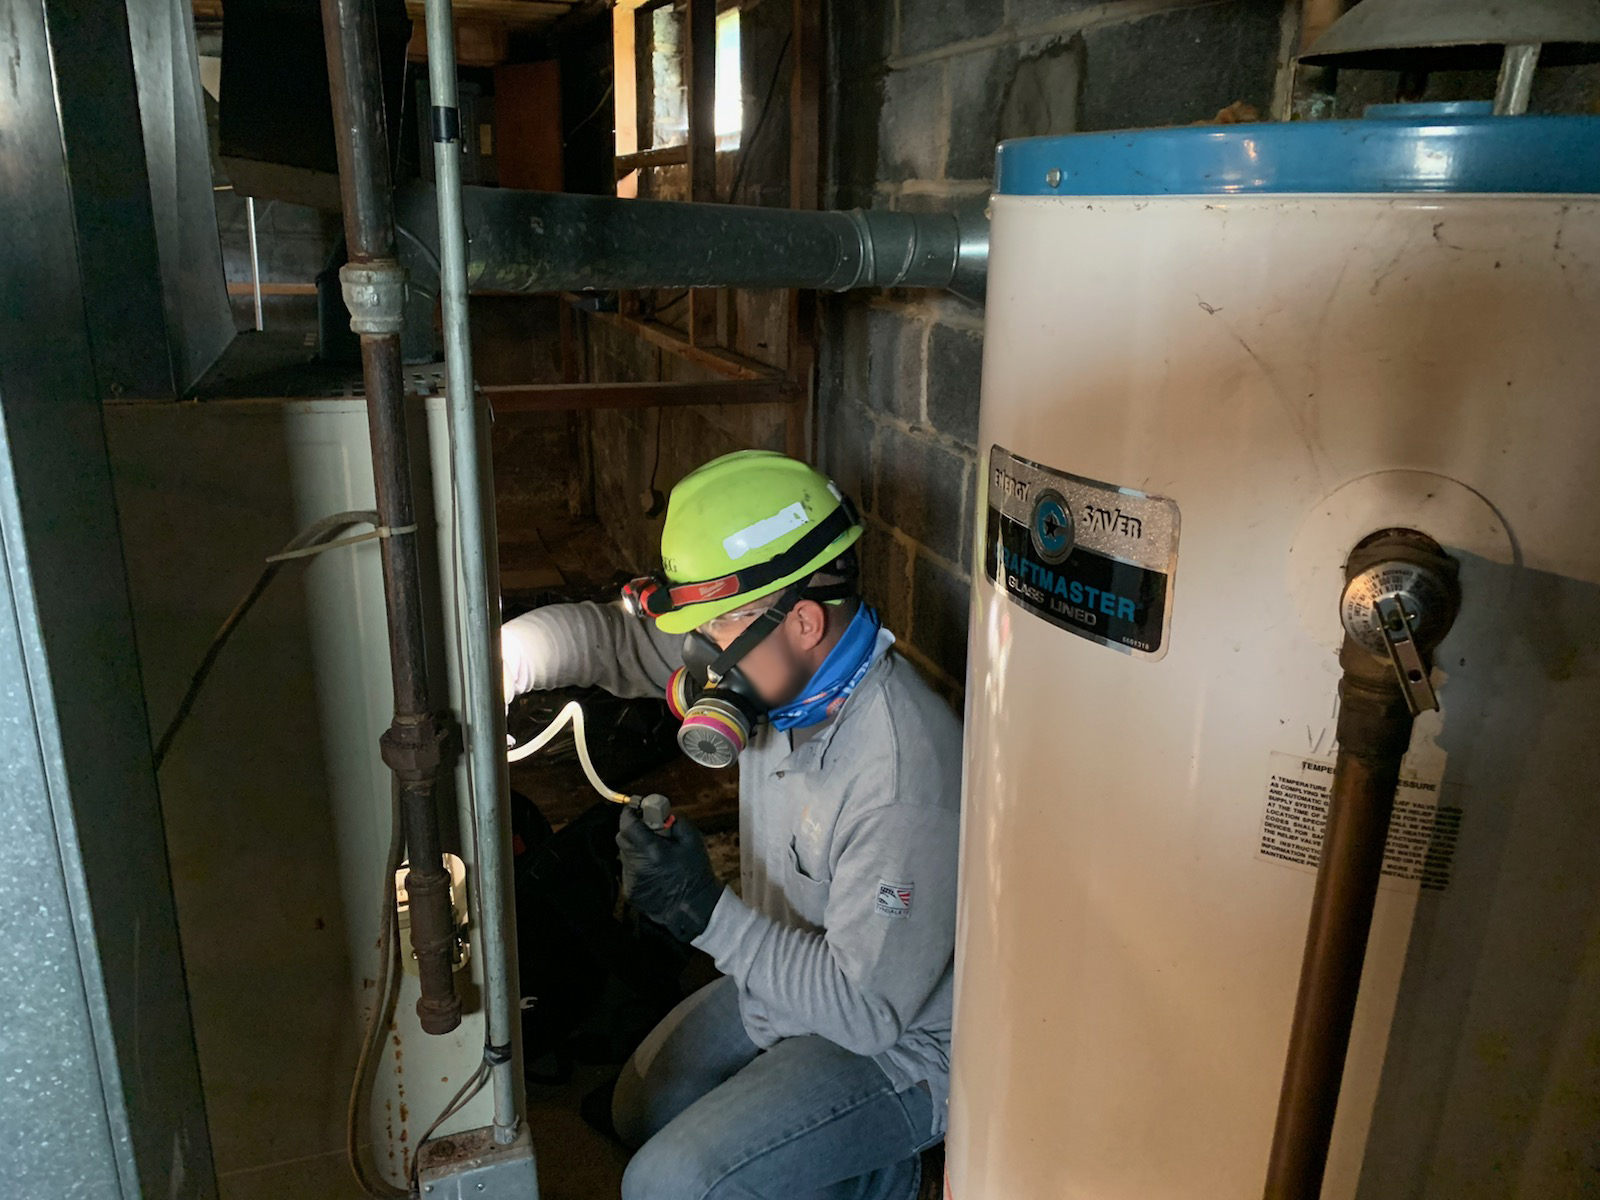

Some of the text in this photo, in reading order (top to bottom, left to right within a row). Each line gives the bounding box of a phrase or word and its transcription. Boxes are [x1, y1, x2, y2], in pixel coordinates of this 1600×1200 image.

[994, 469, 1143, 540] ENERGY SAVER
[996, 541, 1136, 623] RAFTMASTER
[1008, 575, 1097, 627] GLASS LINED
[1279, 776, 1327, 792] TEMPERATURE
[1280, 783, 1318, 797] COMPLYING
[1398, 779, 1436, 791] ESSURE
[1268, 795, 1293, 805] SUPPLY
[1284, 792, 1322, 806] AUTOMATIC
[1266, 809, 1300, 821] LOCATION
[1302, 817, 1327, 827] SPECIF
[1278, 804, 1291, 812] THE
[1293, 807, 1308, 817] TIME
[1265, 815, 1289, 825] CODES
[1293, 822, 1316, 832] SHALL
[1277, 831, 1299, 841] RELIEF
[1300, 837, 1321, 847] VALVE
[1311, 832, 1324, 840] SAF
[1261, 843, 1306, 858] INFORMATION
[1262, 836, 1276, 844] SEE
[1280, 841, 1321, 854] INSTRUCTI
[1260, 849, 1305, 865] MAINTENANCE
[876, 905, 902, 915] TYNDALE
